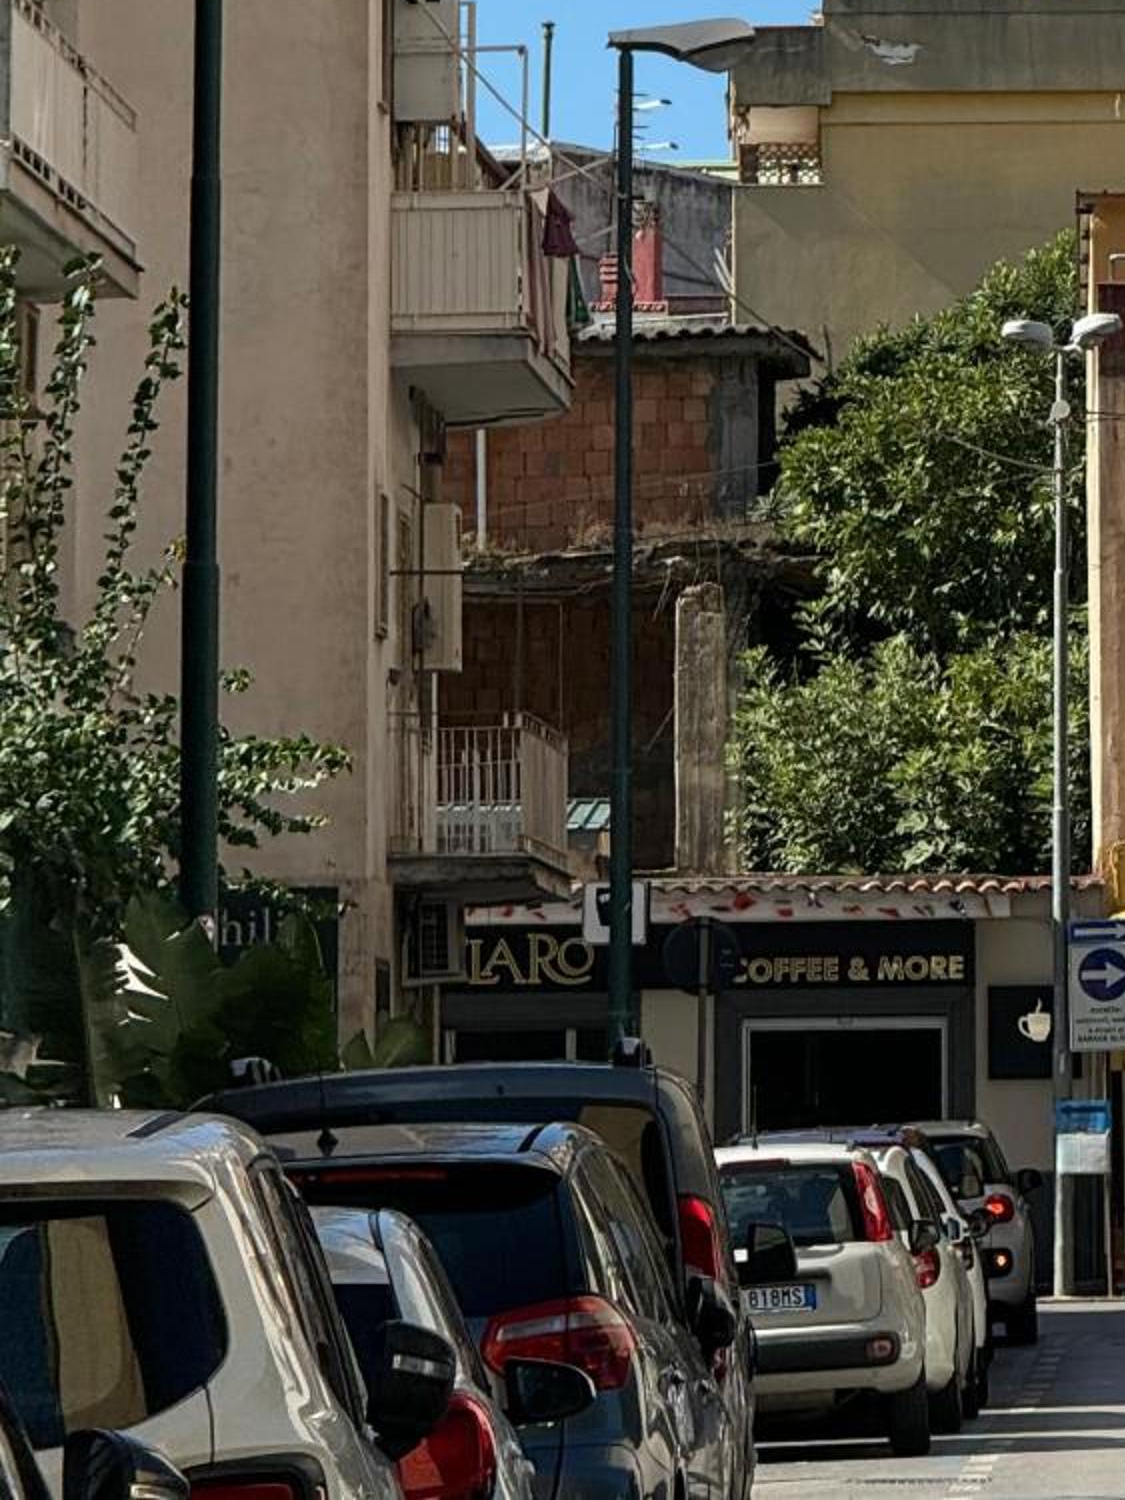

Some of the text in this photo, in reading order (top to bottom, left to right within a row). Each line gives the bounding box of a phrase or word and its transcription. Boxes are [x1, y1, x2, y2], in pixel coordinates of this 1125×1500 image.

[466, 933, 595, 985] LARO
[847, 957, 871, 981] &
[877, 955, 965, 981] MORE
[749, 1287, 802, 1308] 818MS
